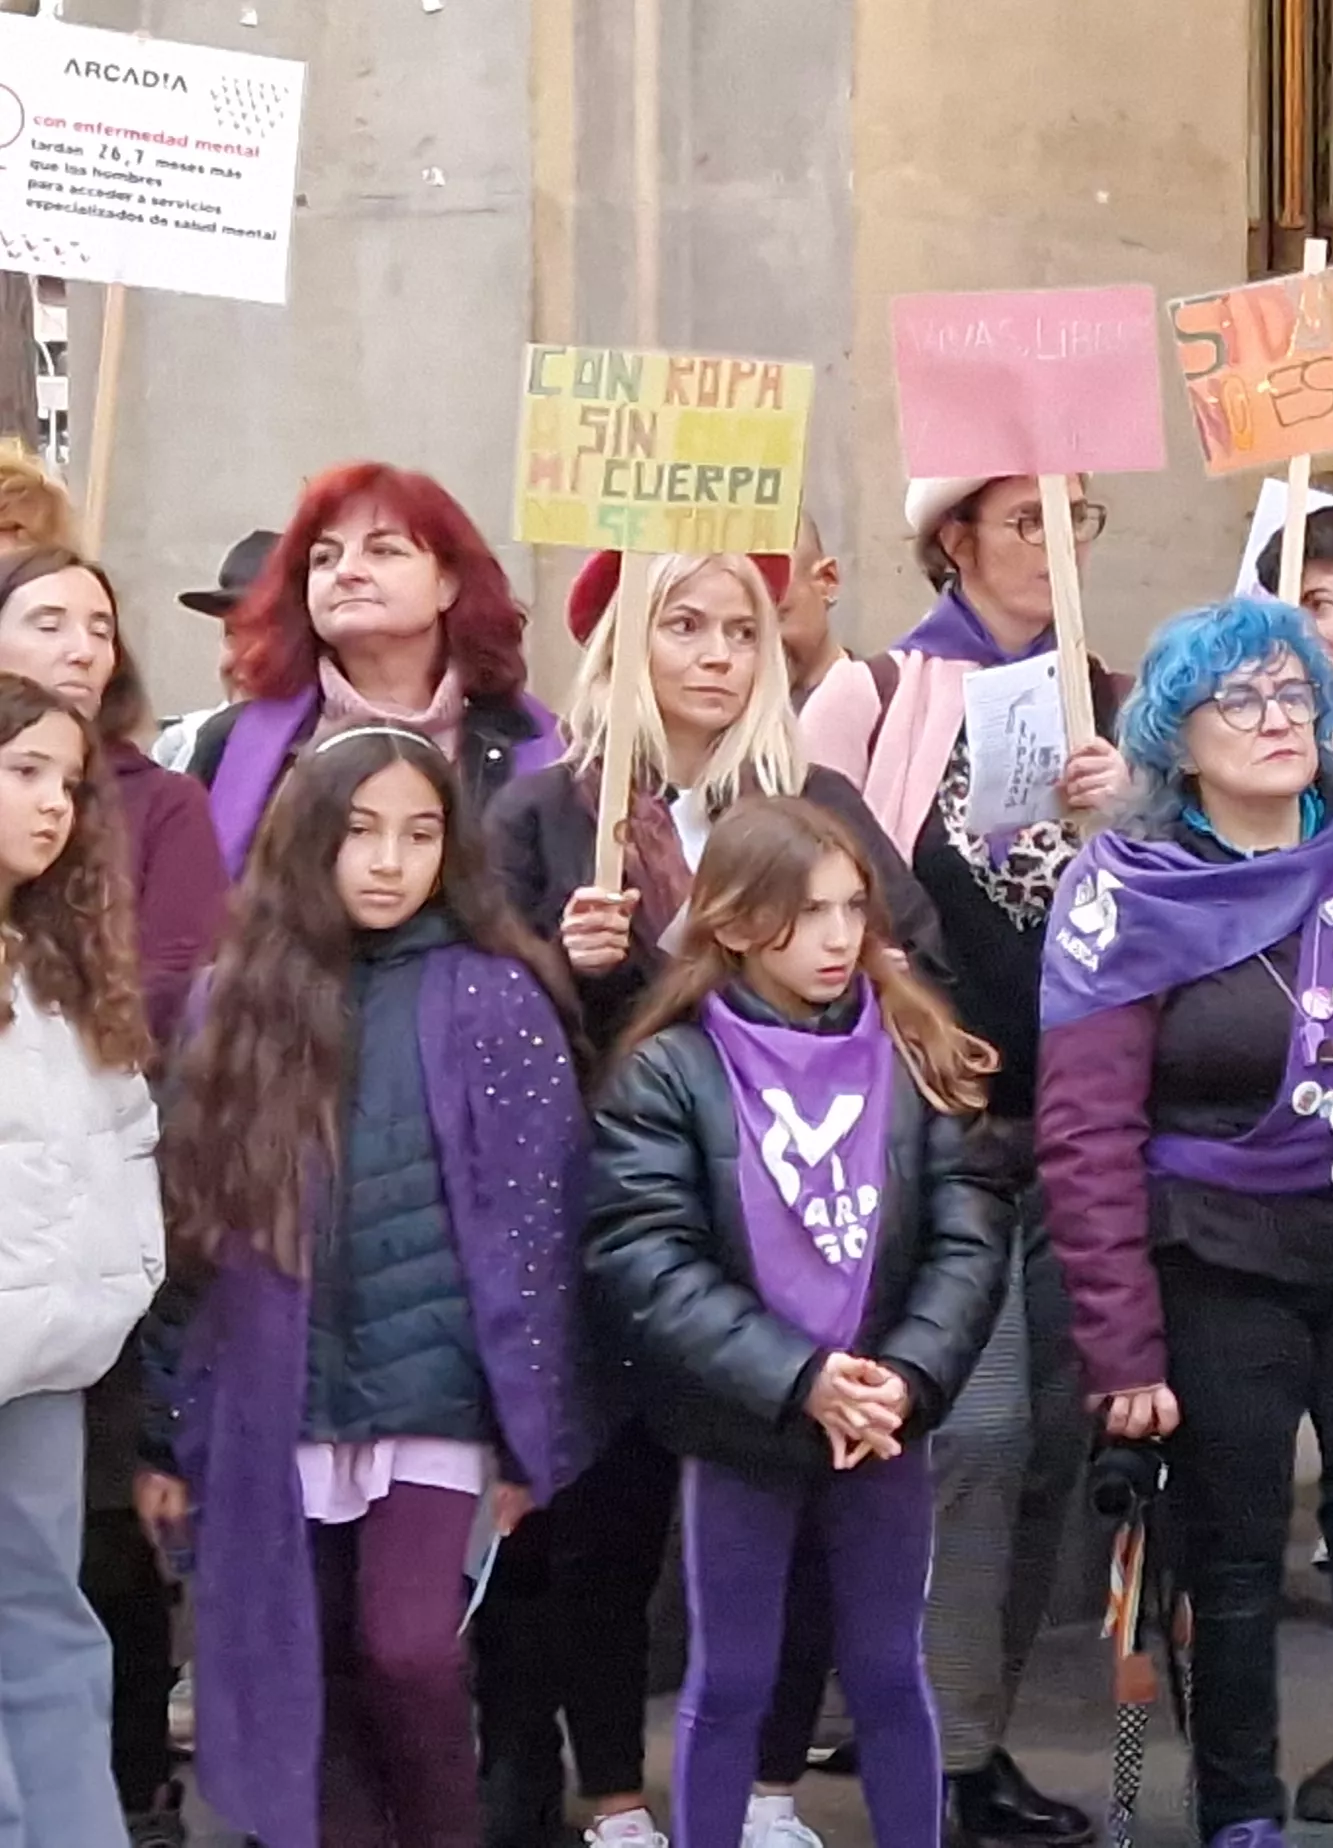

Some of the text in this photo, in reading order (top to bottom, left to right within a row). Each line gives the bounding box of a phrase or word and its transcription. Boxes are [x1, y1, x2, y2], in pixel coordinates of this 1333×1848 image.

[33, 114, 260, 158] con enfermedad mental
[29, 159, 163, 188] que los hombres
[30, 138, 84, 157] tardan
[155, 158, 205, 174] meses
[210, 166, 242, 180] más
[27, 178, 64, 193] para
[69, 184, 133, 203] acceder
[151, 198, 222, 215] servicios
[26, 198, 277, 241] especializados de salud mental
[527, 348, 783, 409] CON ROPA
[577, 402, 658, 460] SIN
[601, 458, 782, 505] CUERPO
